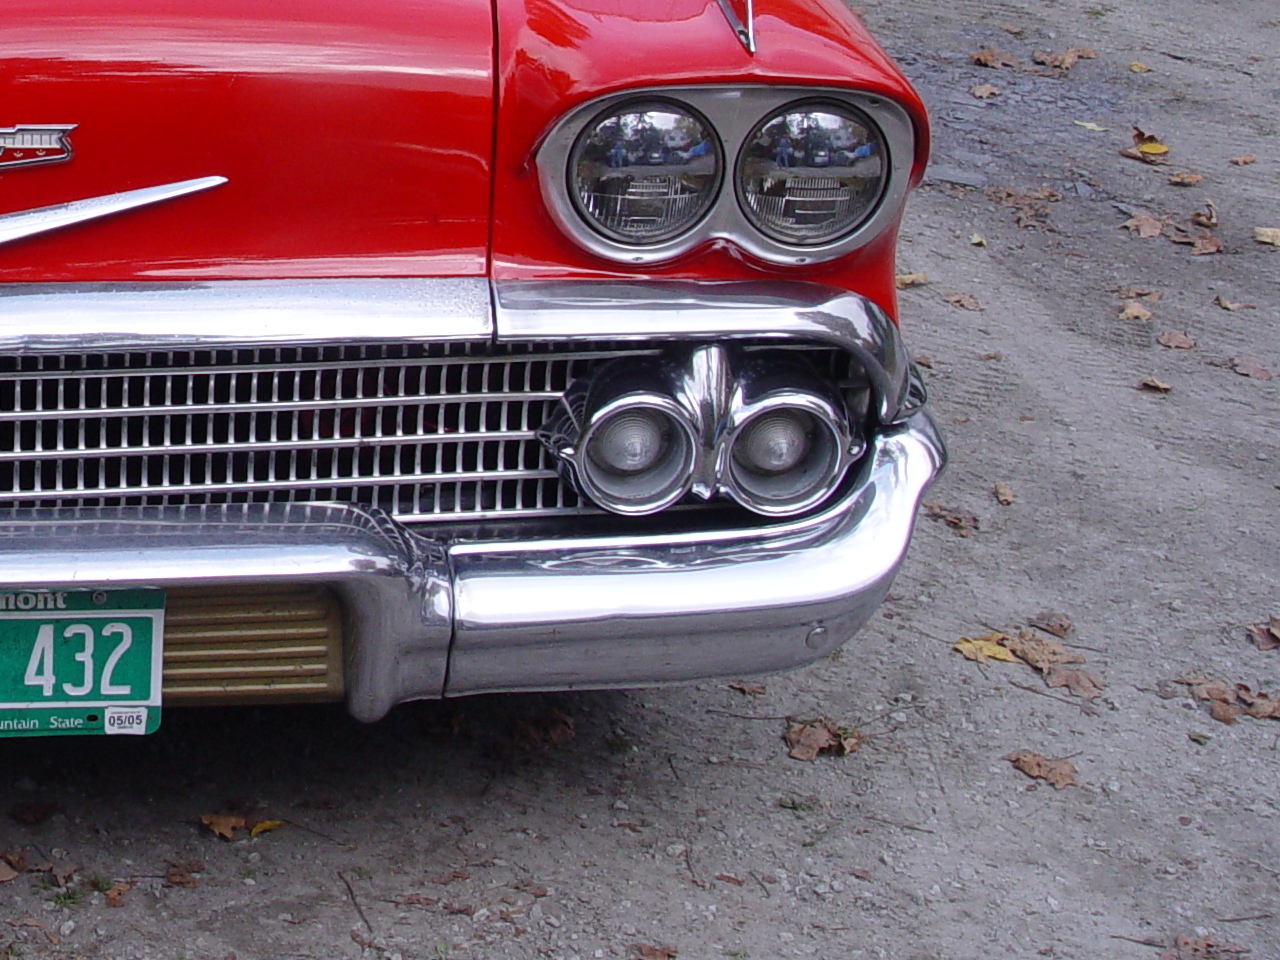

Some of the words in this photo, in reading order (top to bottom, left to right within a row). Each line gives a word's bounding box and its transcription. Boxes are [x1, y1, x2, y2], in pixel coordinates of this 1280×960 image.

[24, 622, 133, 697] 432
[49, 714, 83, 729] State
[108, 714, 143, 727] 05/05
